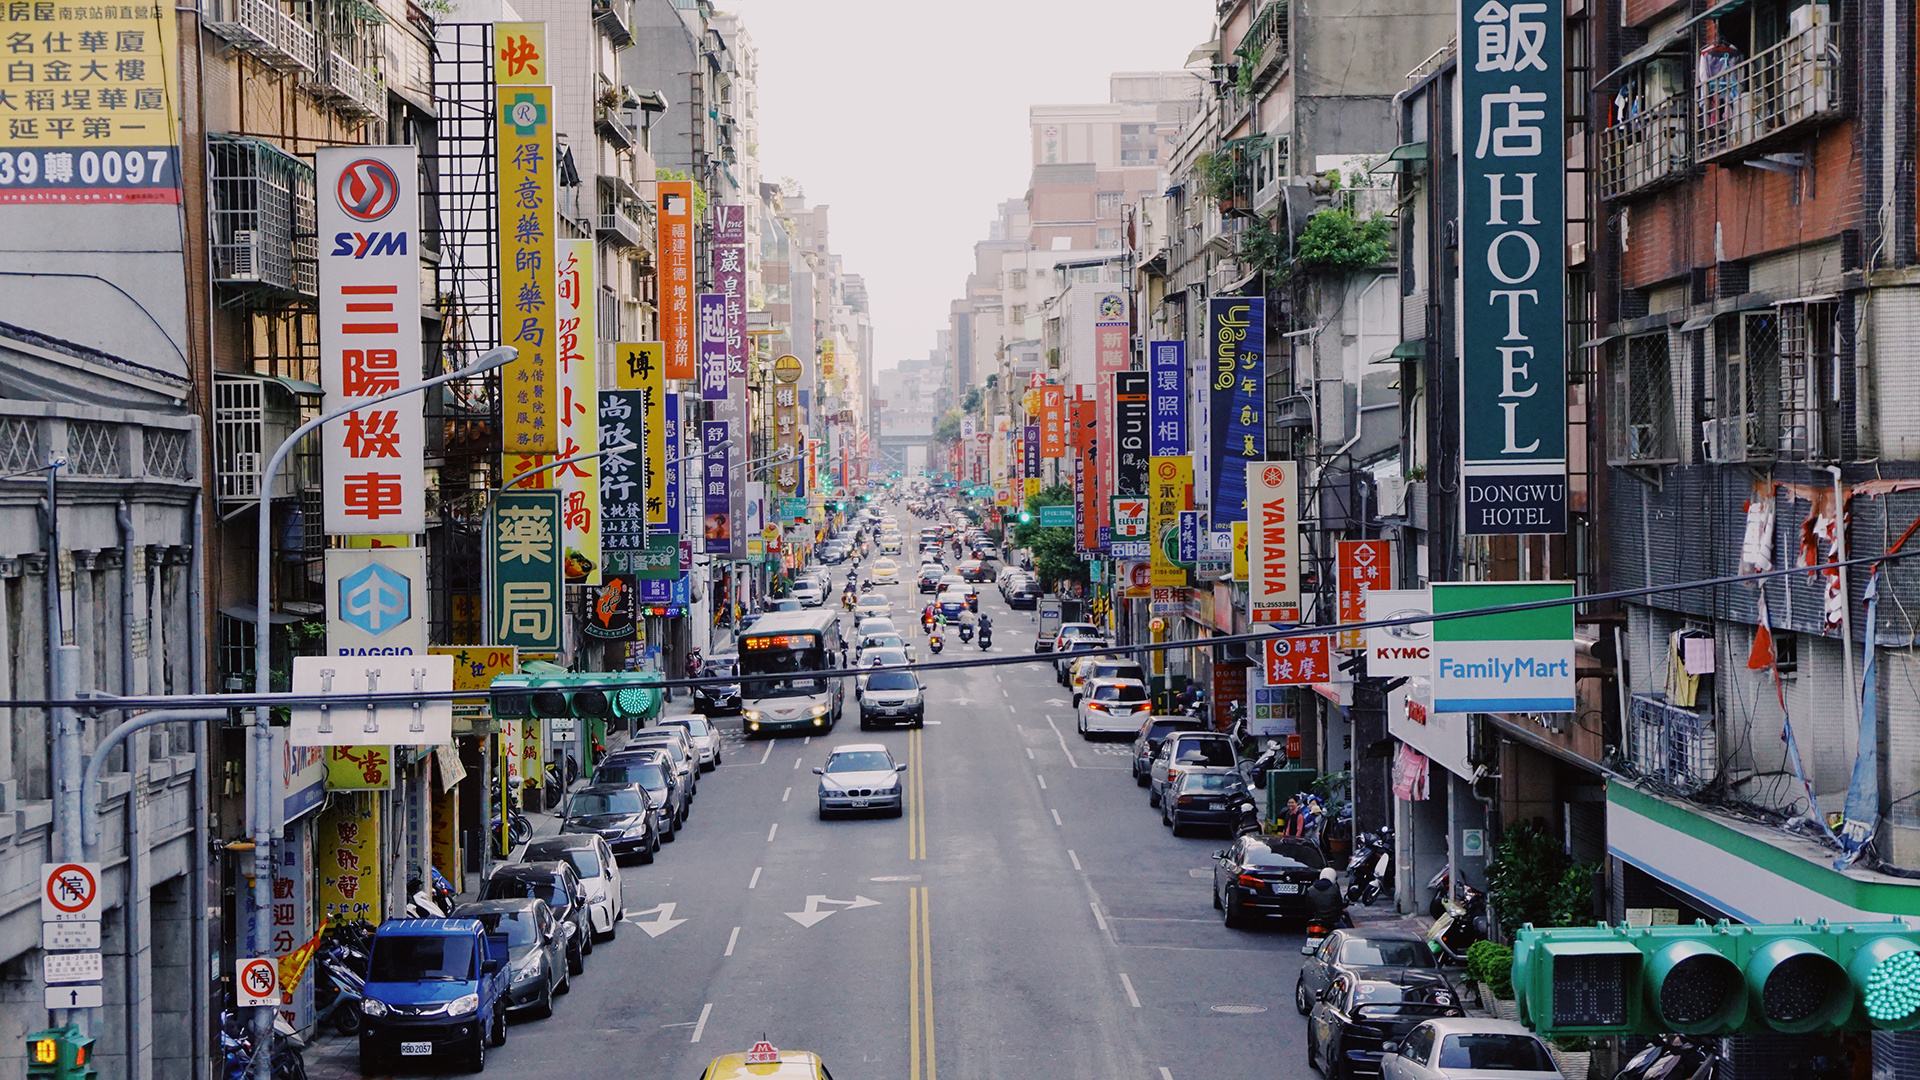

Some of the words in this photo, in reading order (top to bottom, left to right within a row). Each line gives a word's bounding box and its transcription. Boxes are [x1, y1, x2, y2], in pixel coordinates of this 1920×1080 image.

[0, 1, 55, 21] 房屋
[6, 31, 145, 54] 名仕華廈
[8, 59, 146, 83] 白金大樓
[0, 88, 164, 111] 大稻埕華廈
[9, 117, 146, 140] 延平第一
[44, 152, 73, 183] 轉
[79, 151, 168, 184] 0097
[331, 231, 408, 259] SYM
[512, 143, 546, 347] 得意藥師藥局
[1484, 172, 1541, 454] HOTEL
[703, 304, 726, 391] 越海
[341, 285, 402, 520] 三陽機車
[1469, 485, 1563, 503] DONGWU
[1482, 508, 1550, 526] HOTEL
[1262, 497, 1287, 596] YAMAHA
[498, 505, 554, 640] 藥局
[1273, 658, 1316, 680] 按摩
[1439, 657, 1569, 683] FamilyMart
[36, 1039, 56, 1063] 10
